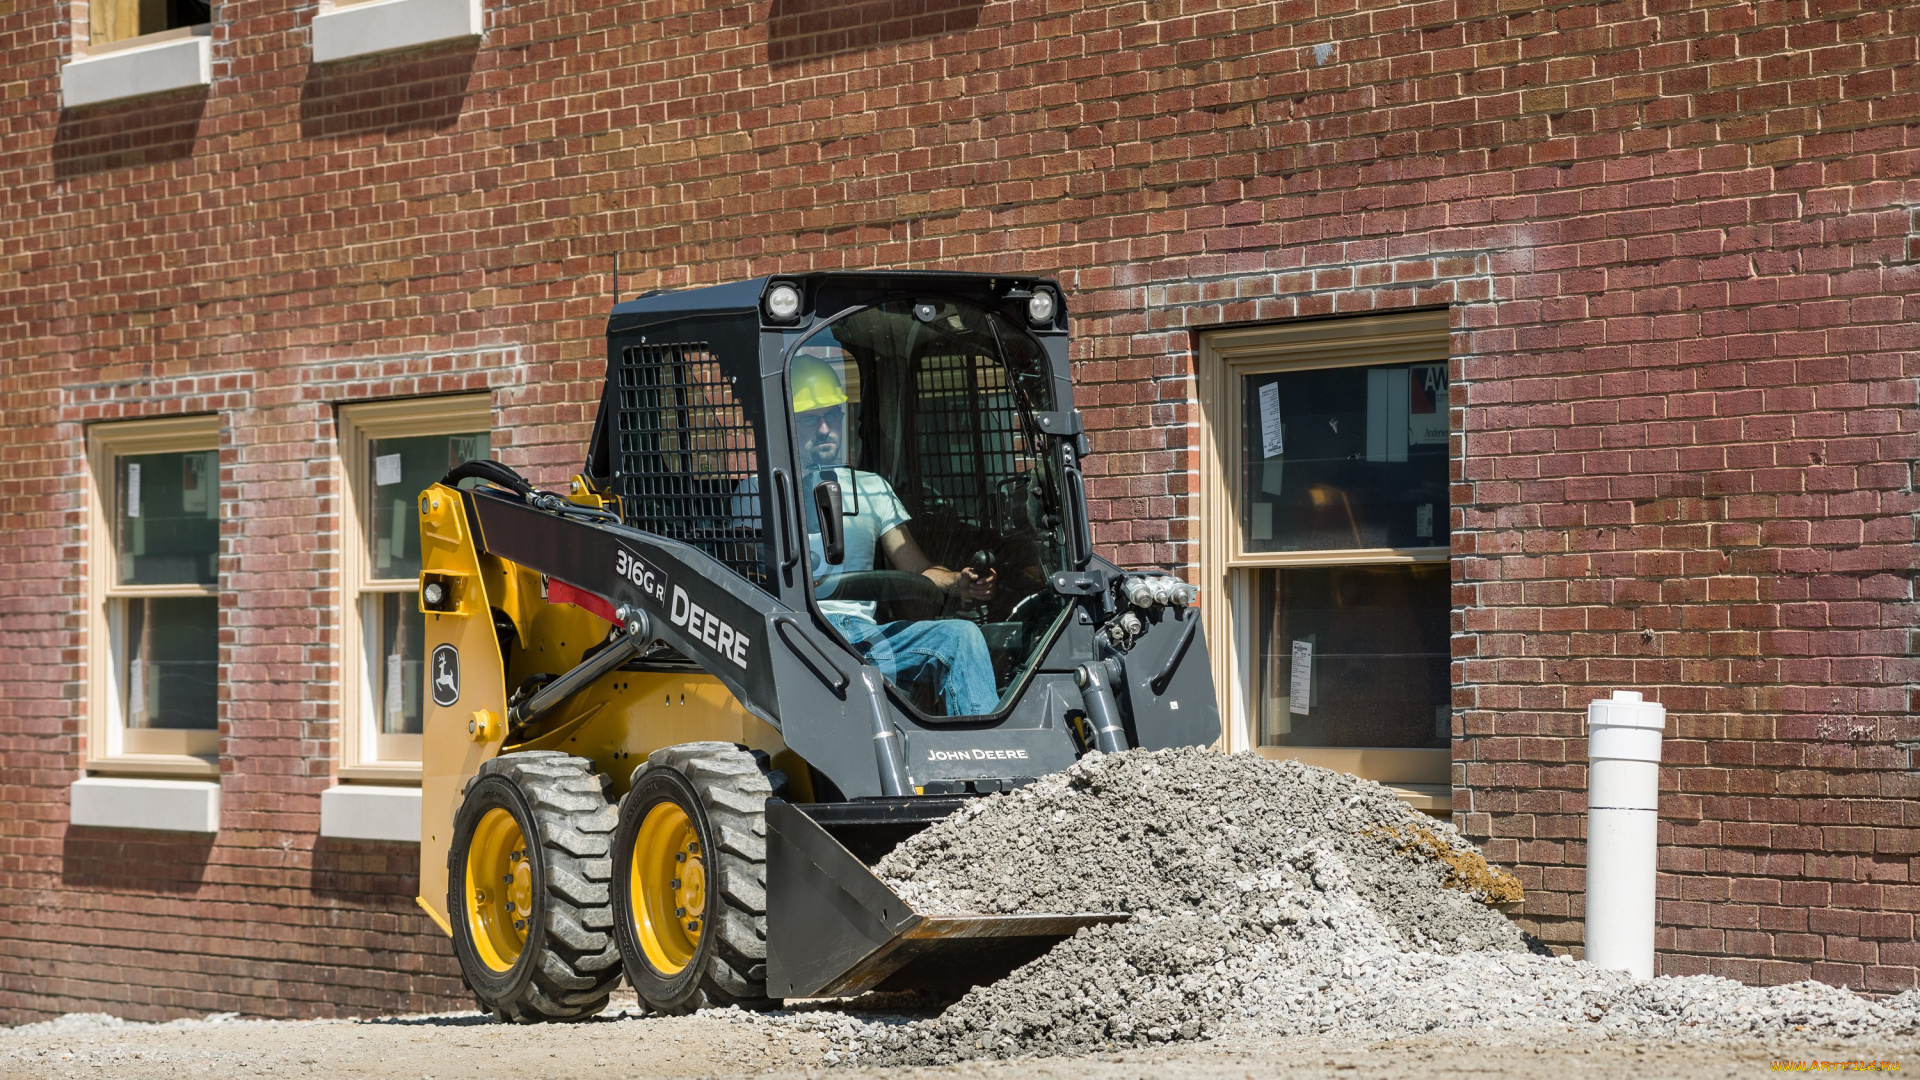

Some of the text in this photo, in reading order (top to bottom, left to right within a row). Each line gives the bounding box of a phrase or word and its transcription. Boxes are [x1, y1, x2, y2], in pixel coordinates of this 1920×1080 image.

[1424, 366, 1449, 391] AW
[1424, 427, 1449, 438] Anderse
[670, 584, 750, 670] DEERE
[927, 748, 1029, 761] JOHN DEERE
